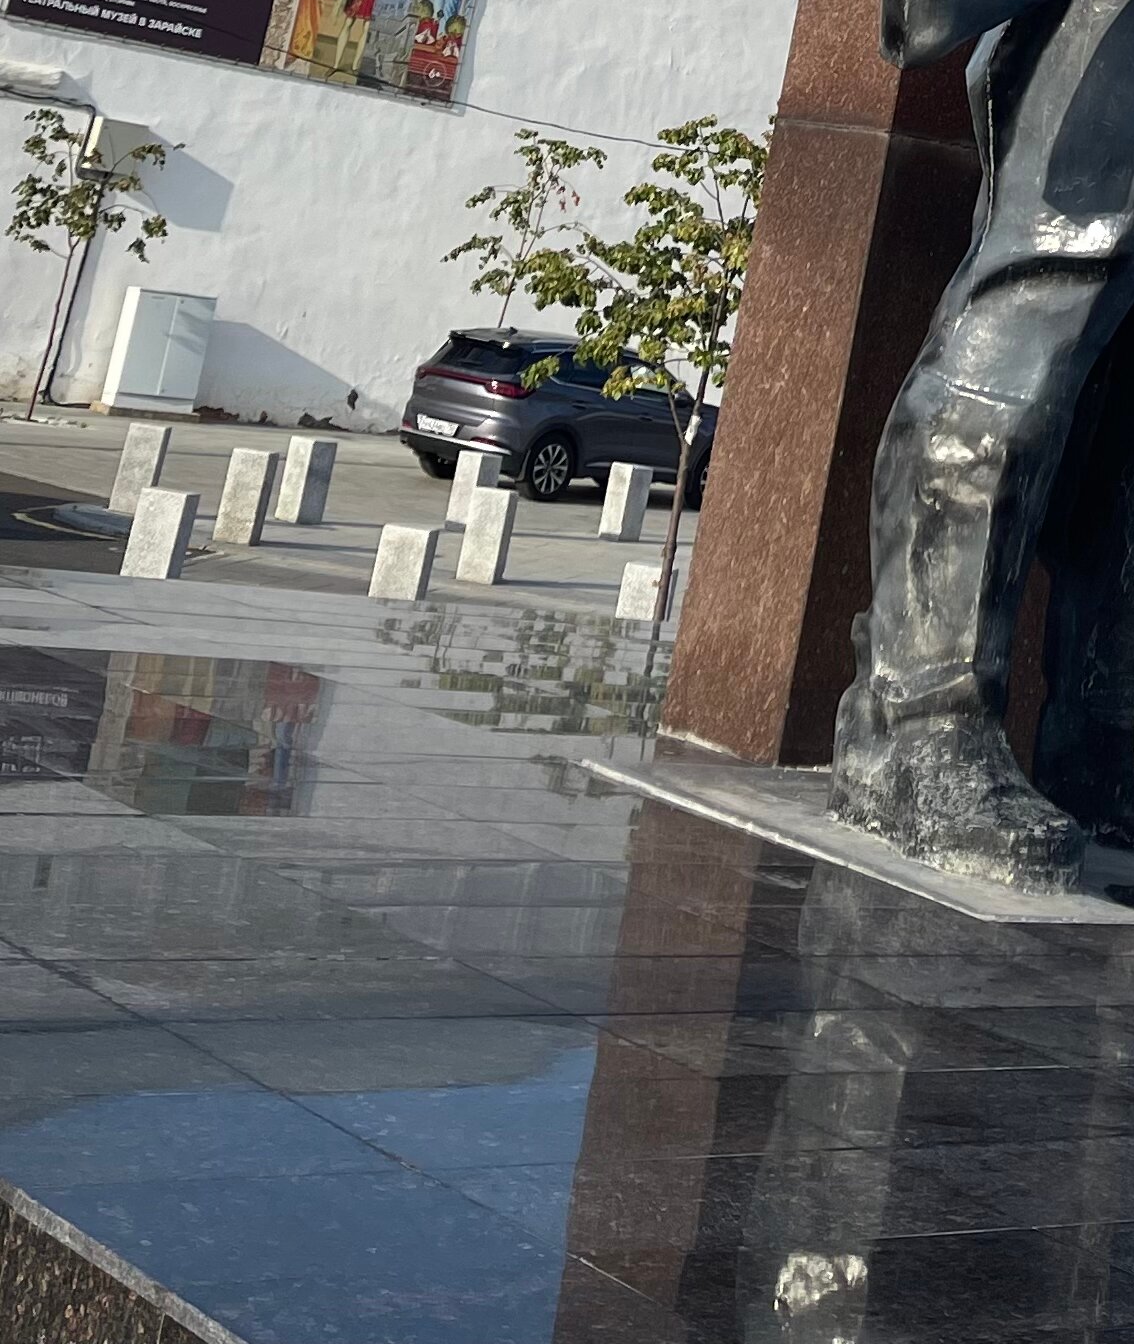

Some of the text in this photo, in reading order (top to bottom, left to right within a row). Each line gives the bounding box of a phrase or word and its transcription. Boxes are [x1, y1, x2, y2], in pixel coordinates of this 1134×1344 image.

[100, 9, 137, 24] МУЗЕЙ
[138, 15, 147, 27] В
[147, 19, 202, 38] ЗАРАЙСКЕ
